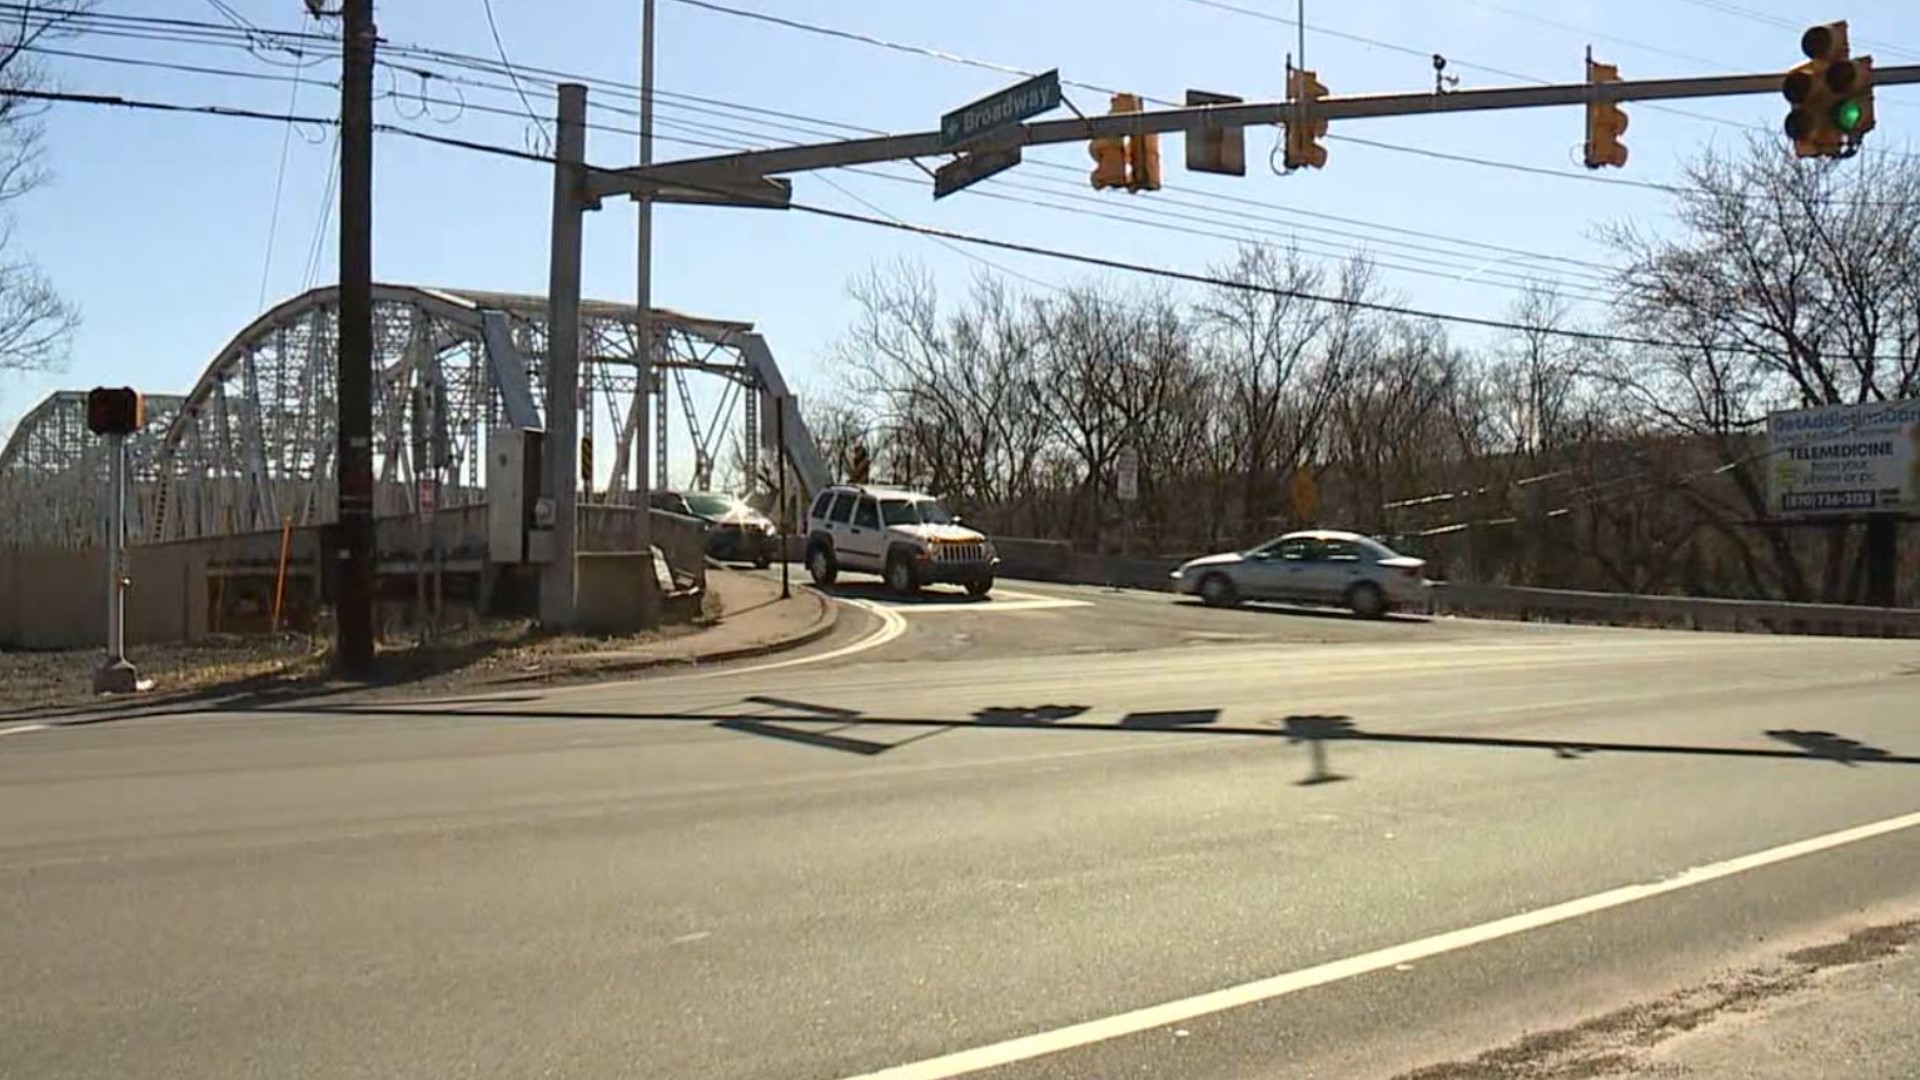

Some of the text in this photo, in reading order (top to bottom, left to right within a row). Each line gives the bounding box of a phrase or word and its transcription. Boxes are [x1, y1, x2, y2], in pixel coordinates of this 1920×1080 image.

[963, 84, 1051, 131] Broadway
[1788, 441, 1893, 460] TELEMEDICINE
[1811, 460, 1868, 472] from your
[1844, 474, 1857, 483] or
